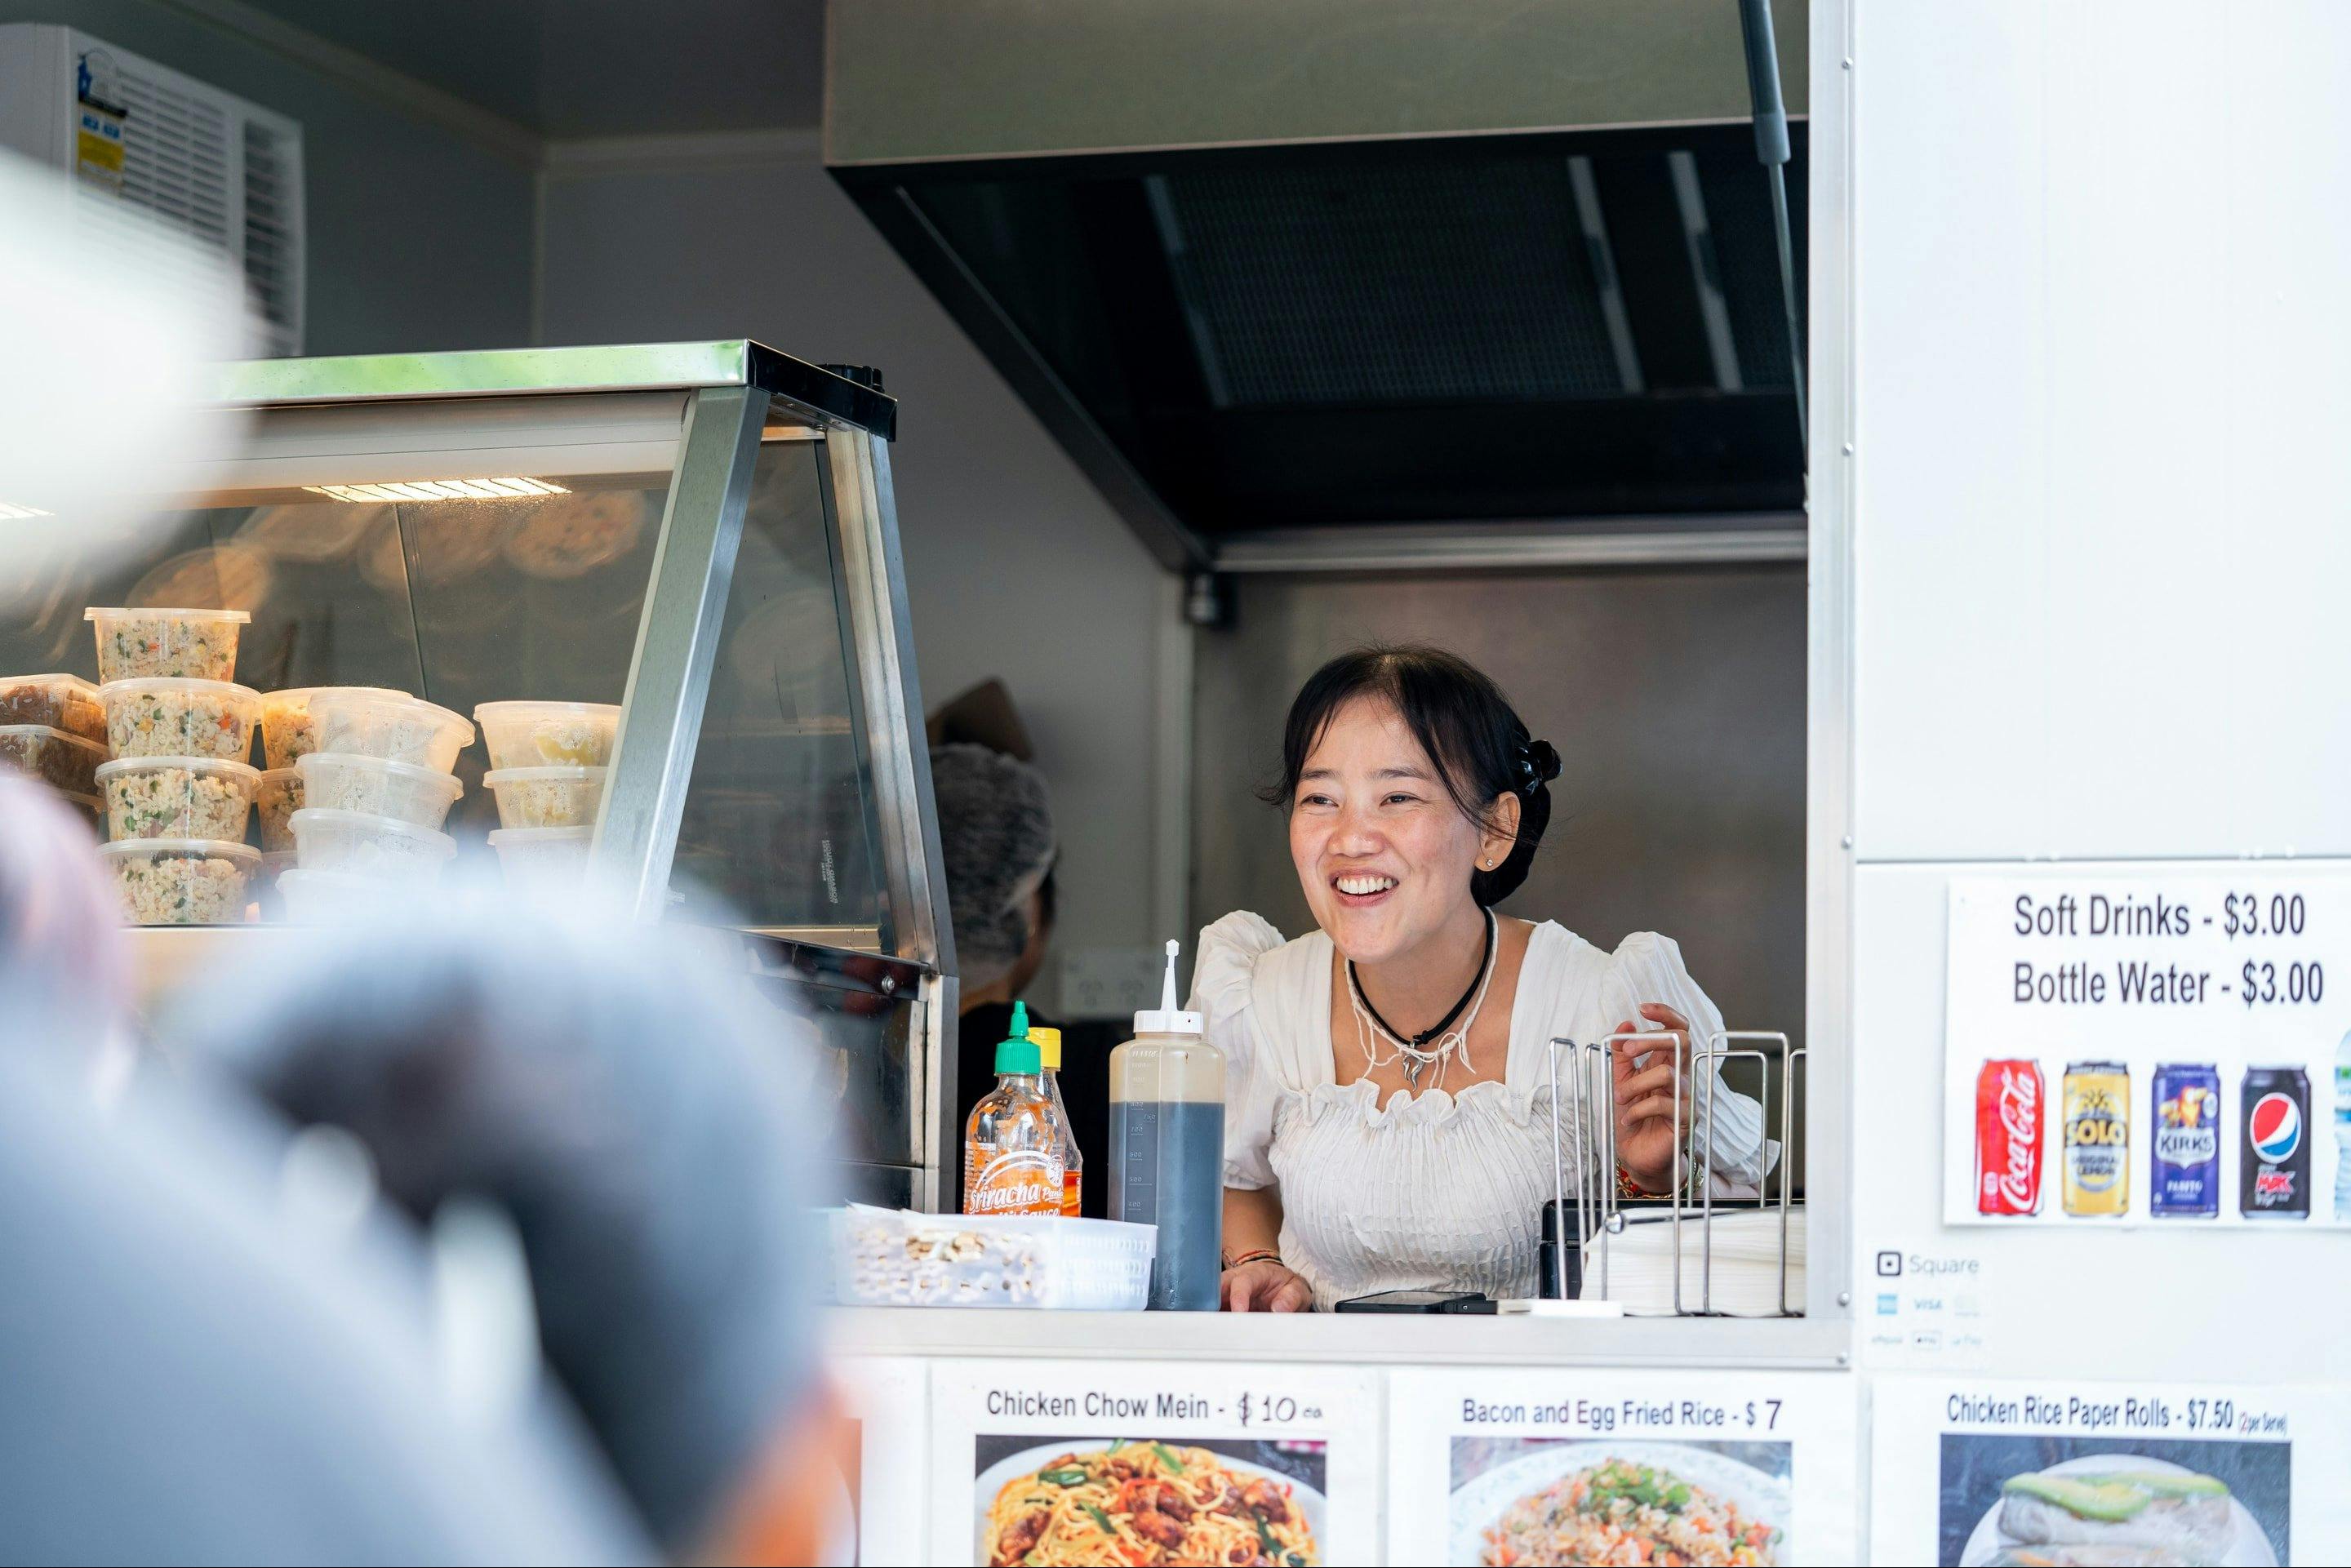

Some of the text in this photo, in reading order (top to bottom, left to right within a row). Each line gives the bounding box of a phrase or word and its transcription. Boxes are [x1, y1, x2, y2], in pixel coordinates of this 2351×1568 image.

[2014, 894, 2078, 936] Soft
[2090, 894, 2190, 936] Drinks
[2224, 891, 2305, 941] $3.00
[2014, 962, 2106, 1004] Bottle
[2118, 961, 2211, 1004] Water
[2242, 958, 2323, 1009] $3.00
[2066, 1118, 2127, 1147] SOLO
[2160, 1135, 2212, 1153] KIRKS
[969, 1184, 1042, 1213] Sriracha
[1909, 1254, 1980, 1277] Square
[987, 1390, 1076, 1417] Chicken
[1084, 1391, 1149, 1418] Chow
[1156, 1393, 1208, 1419] Mein
[1463, 1398, 1526, 1423] Bacon
[1533, 1400, 1569, 1424] and
[1577, 1400, 1615, 1432] Egg
[1623, 1401, 1673, 1425] Fried
[1682, 1401, 1725, 1426] Rice
[1946, 1394, 2018, 1425] Chicken
[2024, 1395, 2062, 1425] Rice
[2069, 1396, 2120, 1430] Paper
[2125, 1397, 2170, 1428] Rolls
[2188, 1397, 2233, 1431] $7.50
